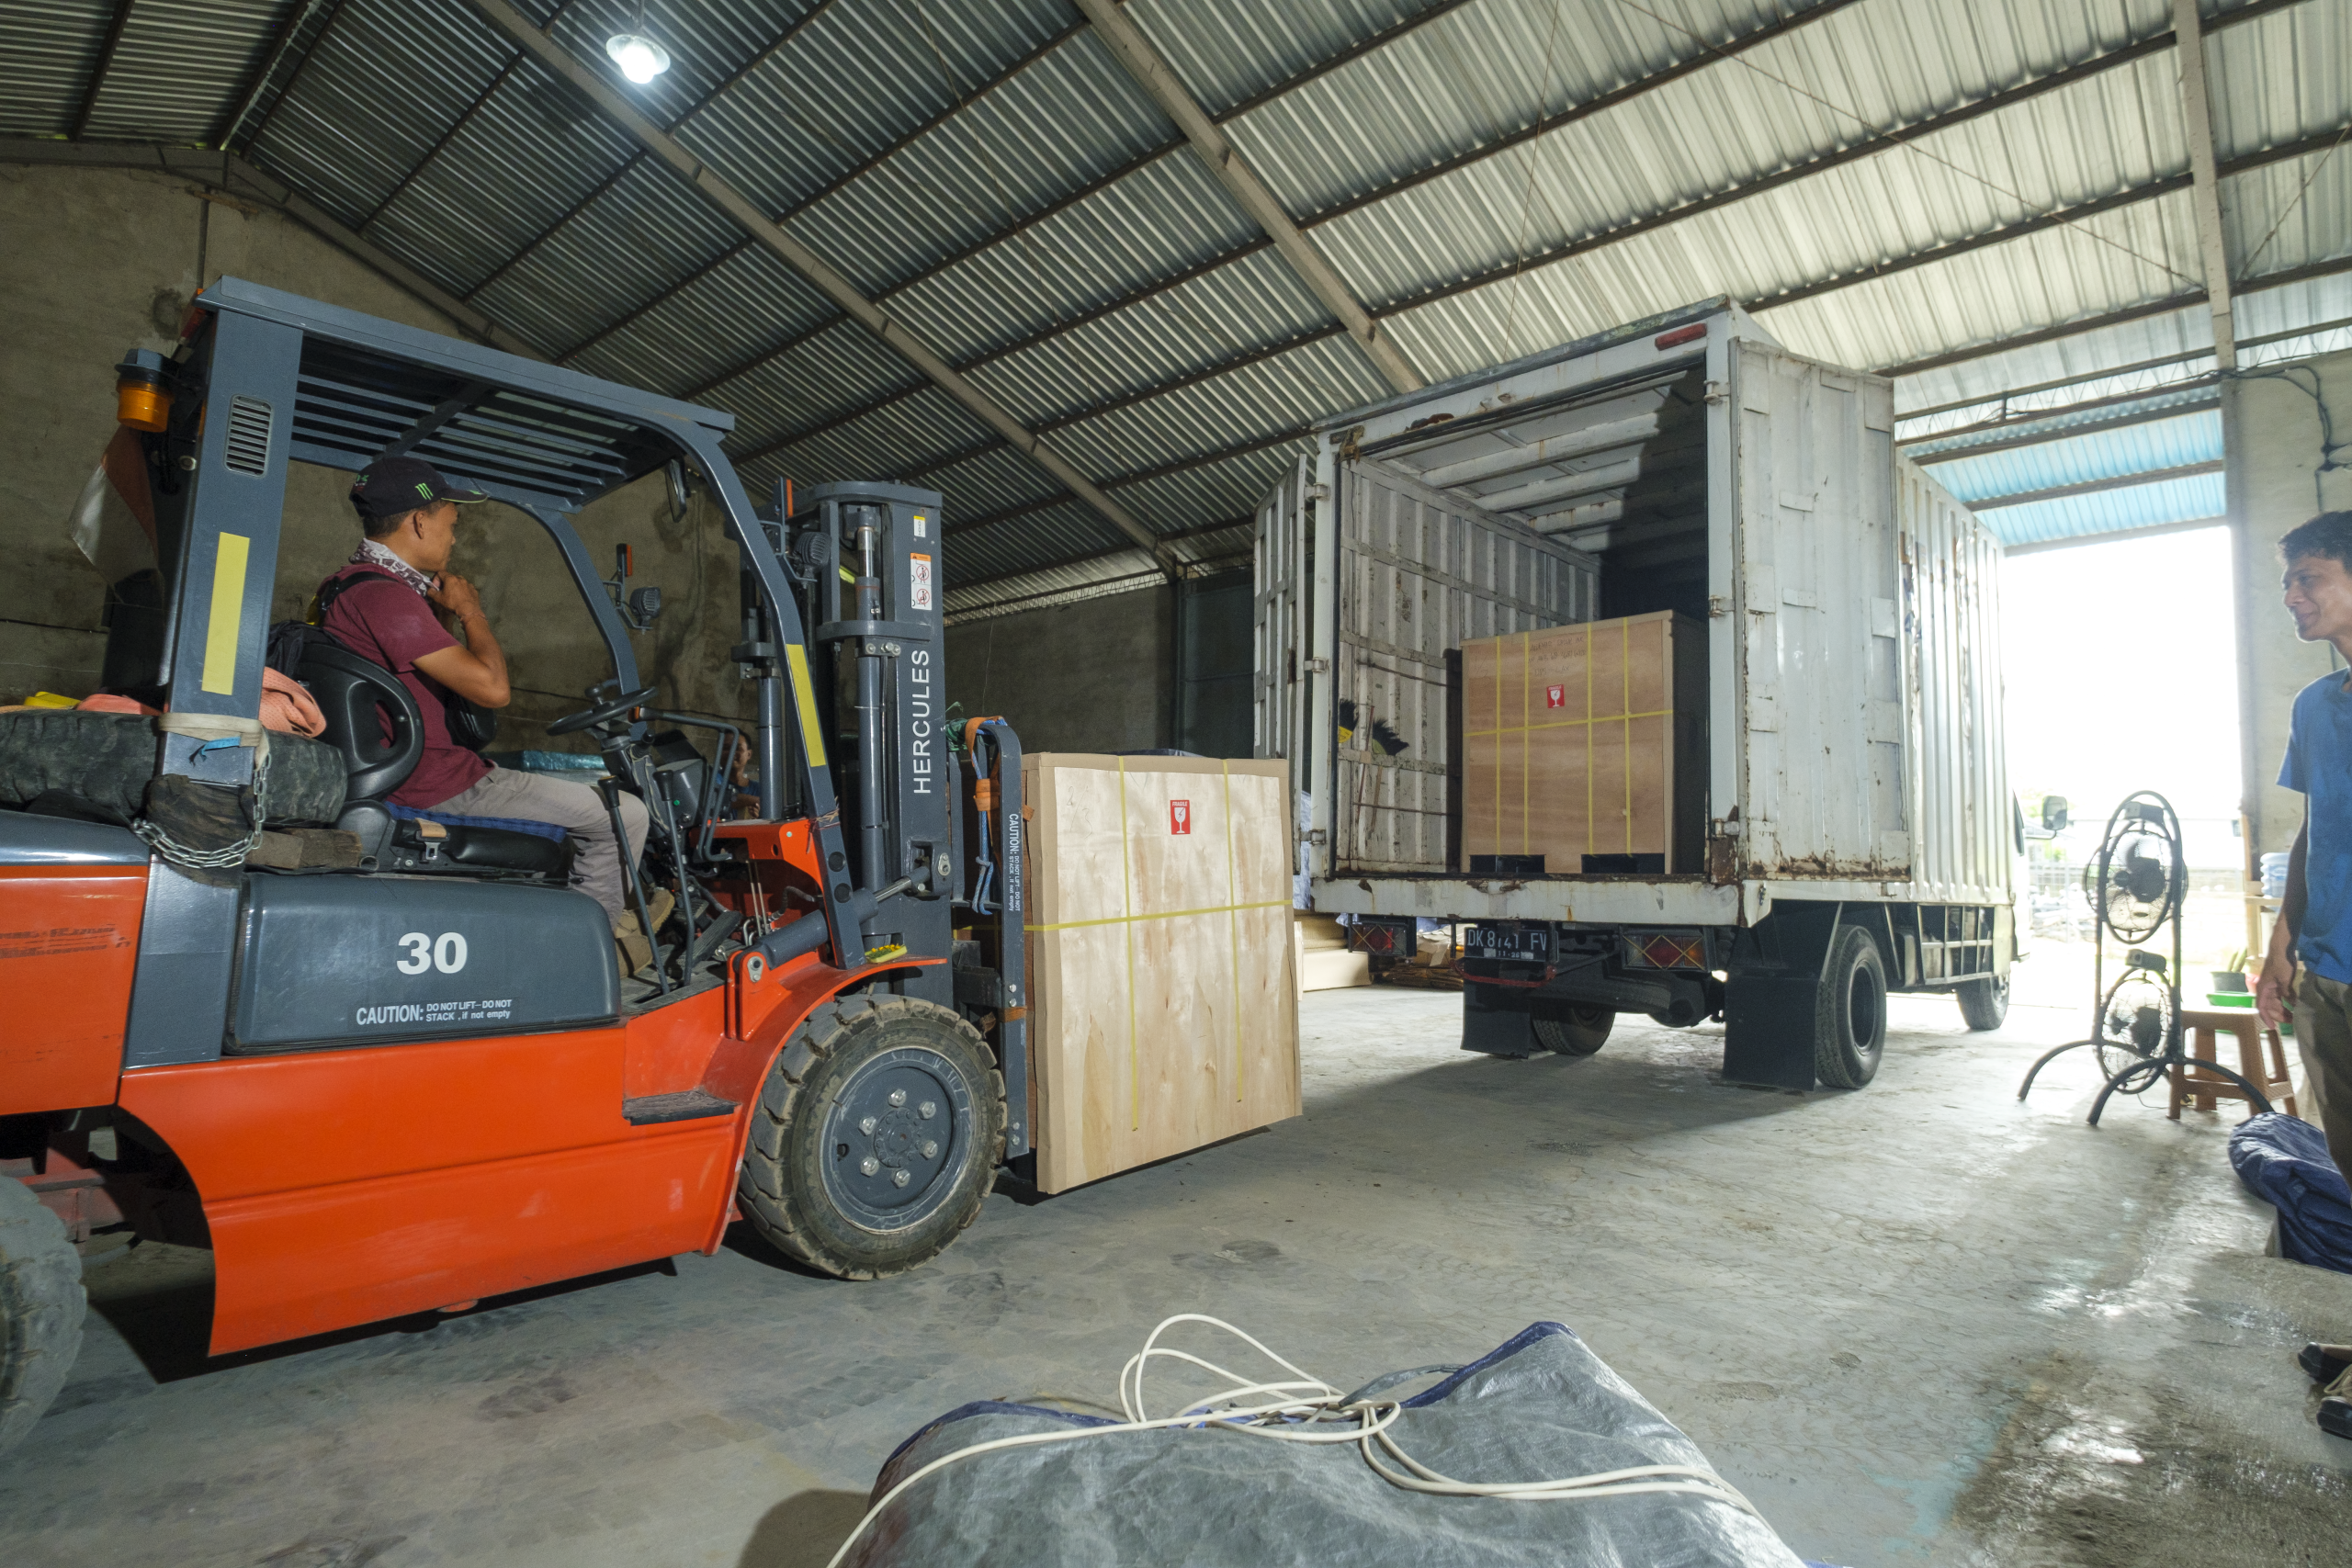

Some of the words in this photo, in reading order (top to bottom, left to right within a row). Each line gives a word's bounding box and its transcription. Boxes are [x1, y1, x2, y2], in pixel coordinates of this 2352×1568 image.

[911, 649, 931, 794] HERCULES
[1467, 929, 1484, 947] DK
[1530, 932, 1546, 951] FV
[396, 931, 469, 976] 30
[356, 1004, 424, 1026] CAUTION:
[426, 1003, 439, 1011] DO
[440, 1002, 458, 1010] NOT
[495, 998, 513, 1008] NOT
[426, 1012, 455, 1022] STACK
[470, 1010, 483, 1020] not
[487, 1010, 511, 1020] empty
